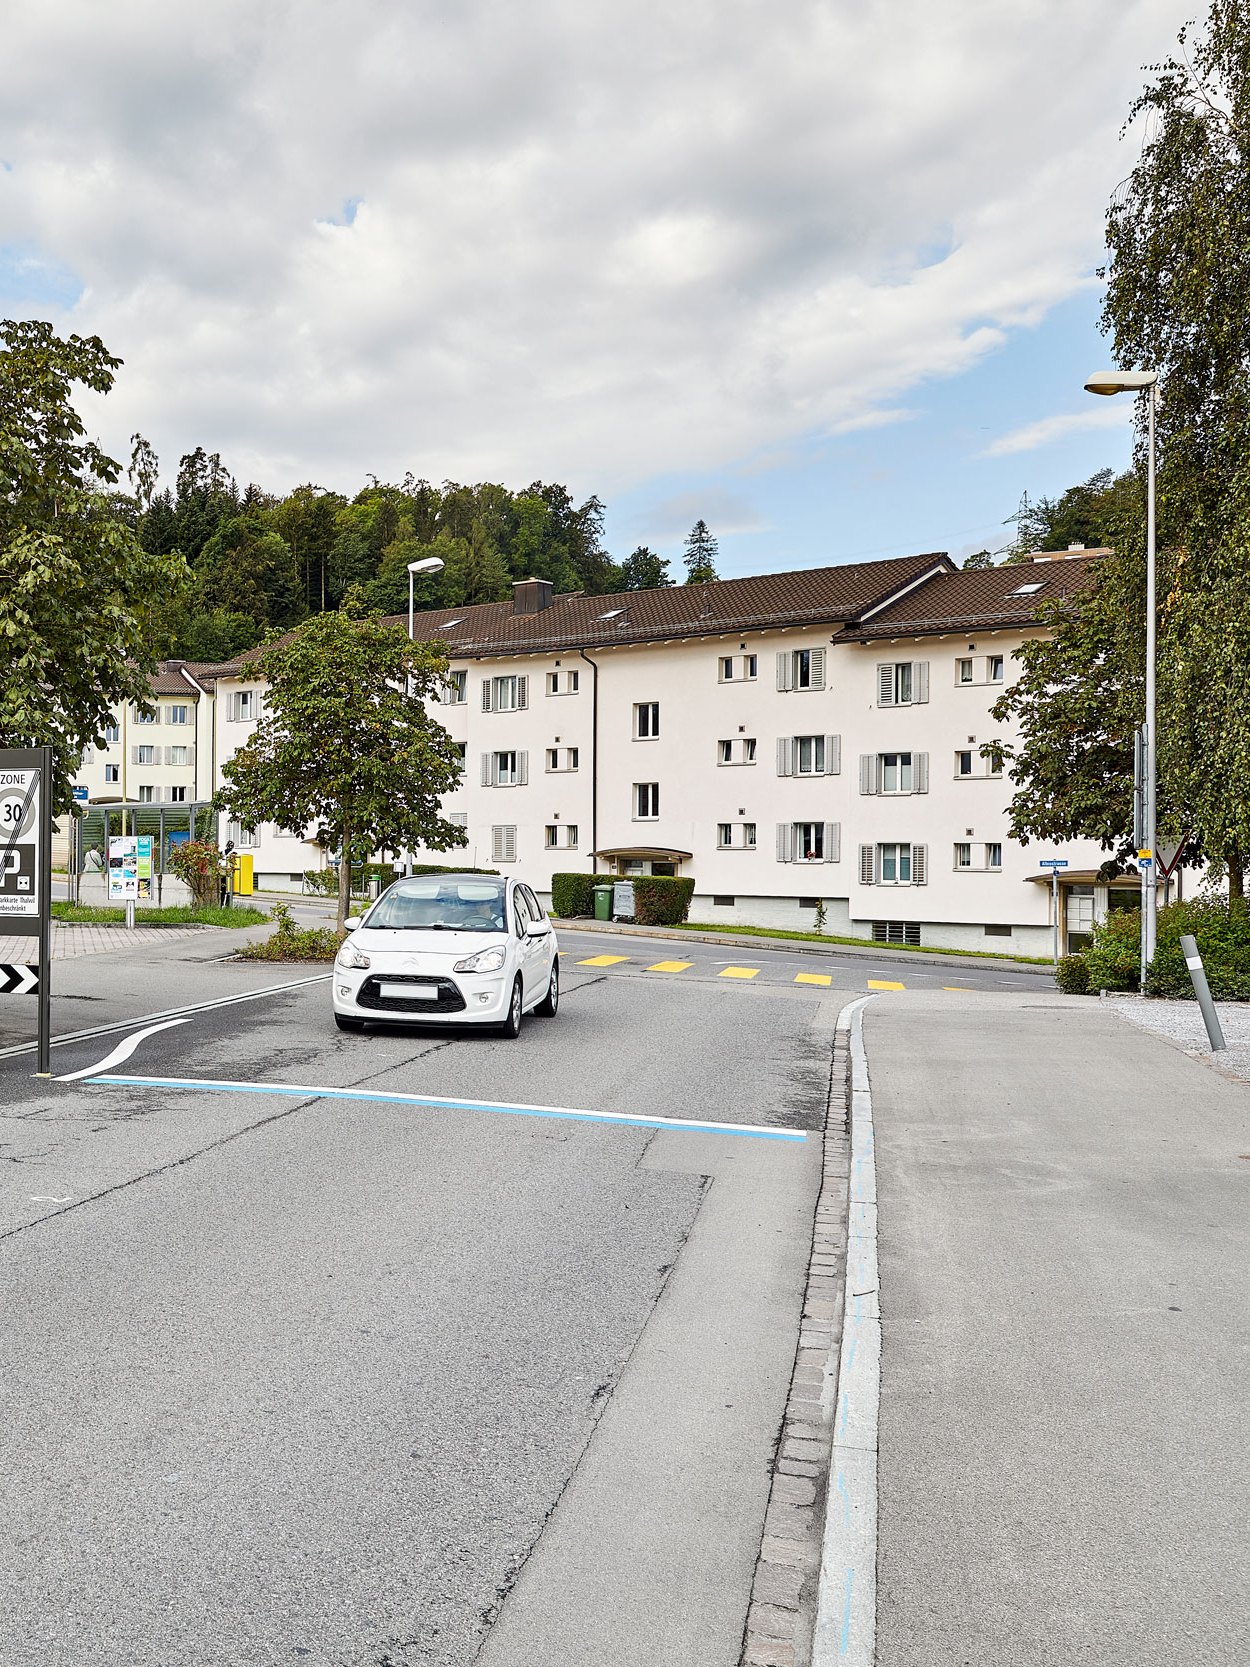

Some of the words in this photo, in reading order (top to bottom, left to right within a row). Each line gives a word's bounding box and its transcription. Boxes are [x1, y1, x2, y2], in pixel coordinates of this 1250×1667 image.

[0, 774, 26, 785] ZONE
[3, 803, 23, 822] 30
[19, 896, 36, 904] Thalwil
